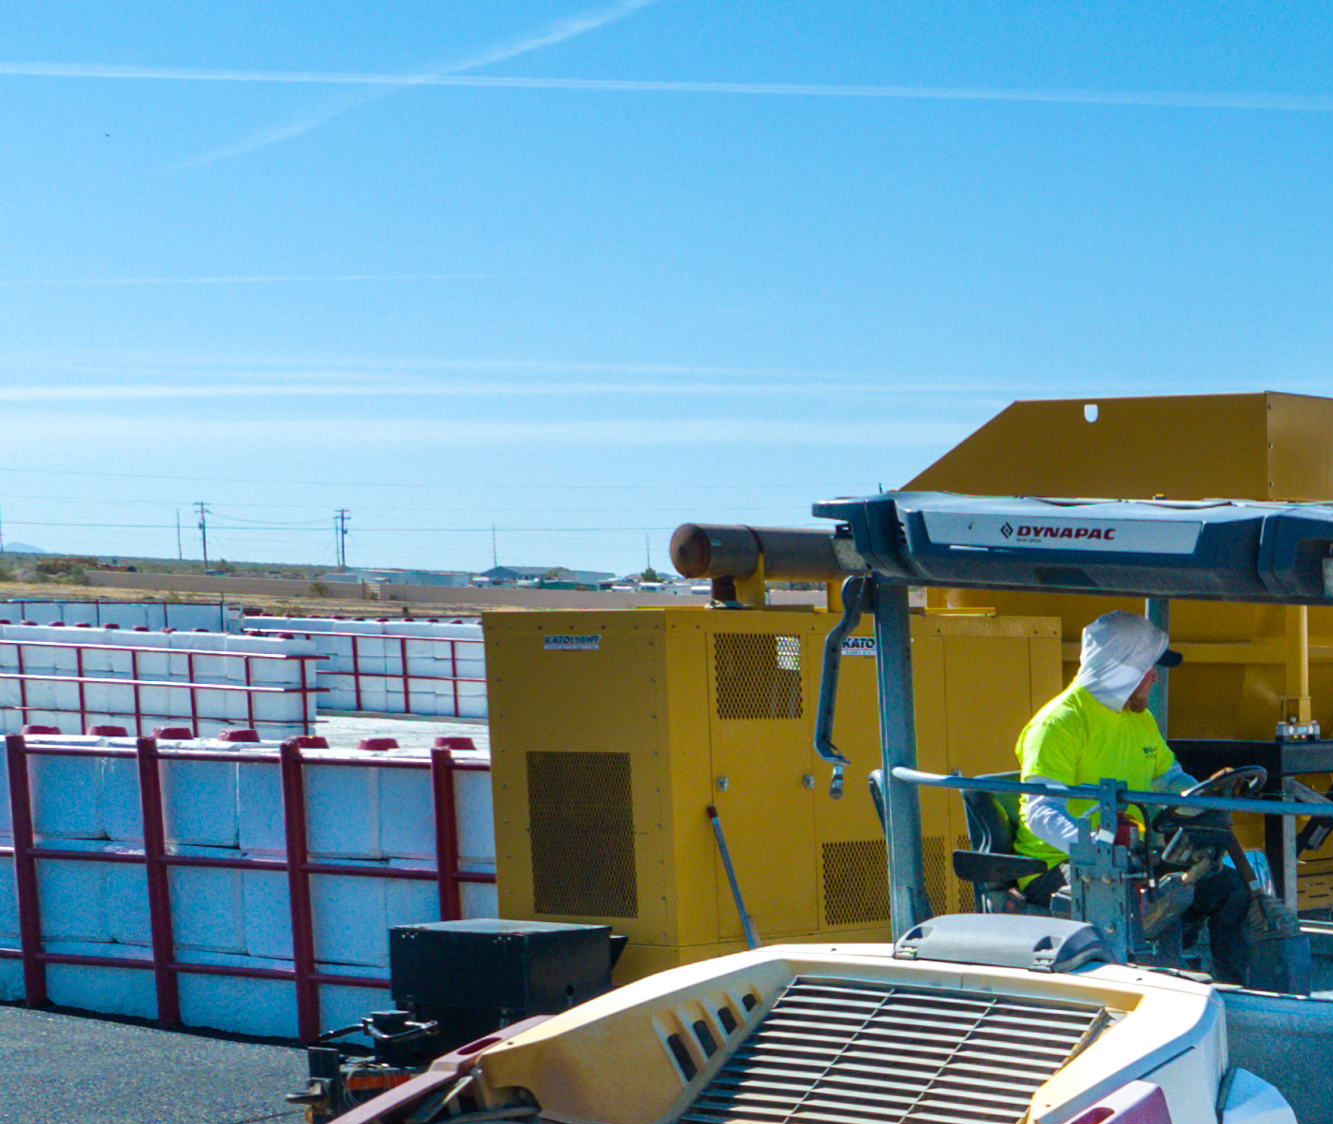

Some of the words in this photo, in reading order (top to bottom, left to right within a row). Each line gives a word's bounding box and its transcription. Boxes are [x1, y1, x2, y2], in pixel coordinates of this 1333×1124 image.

[1016, 525, 1116, 540] DYNAPAC
[544, 635, 600, 644] KATOLIGHT
[842, 637, 876, 648] KATO
